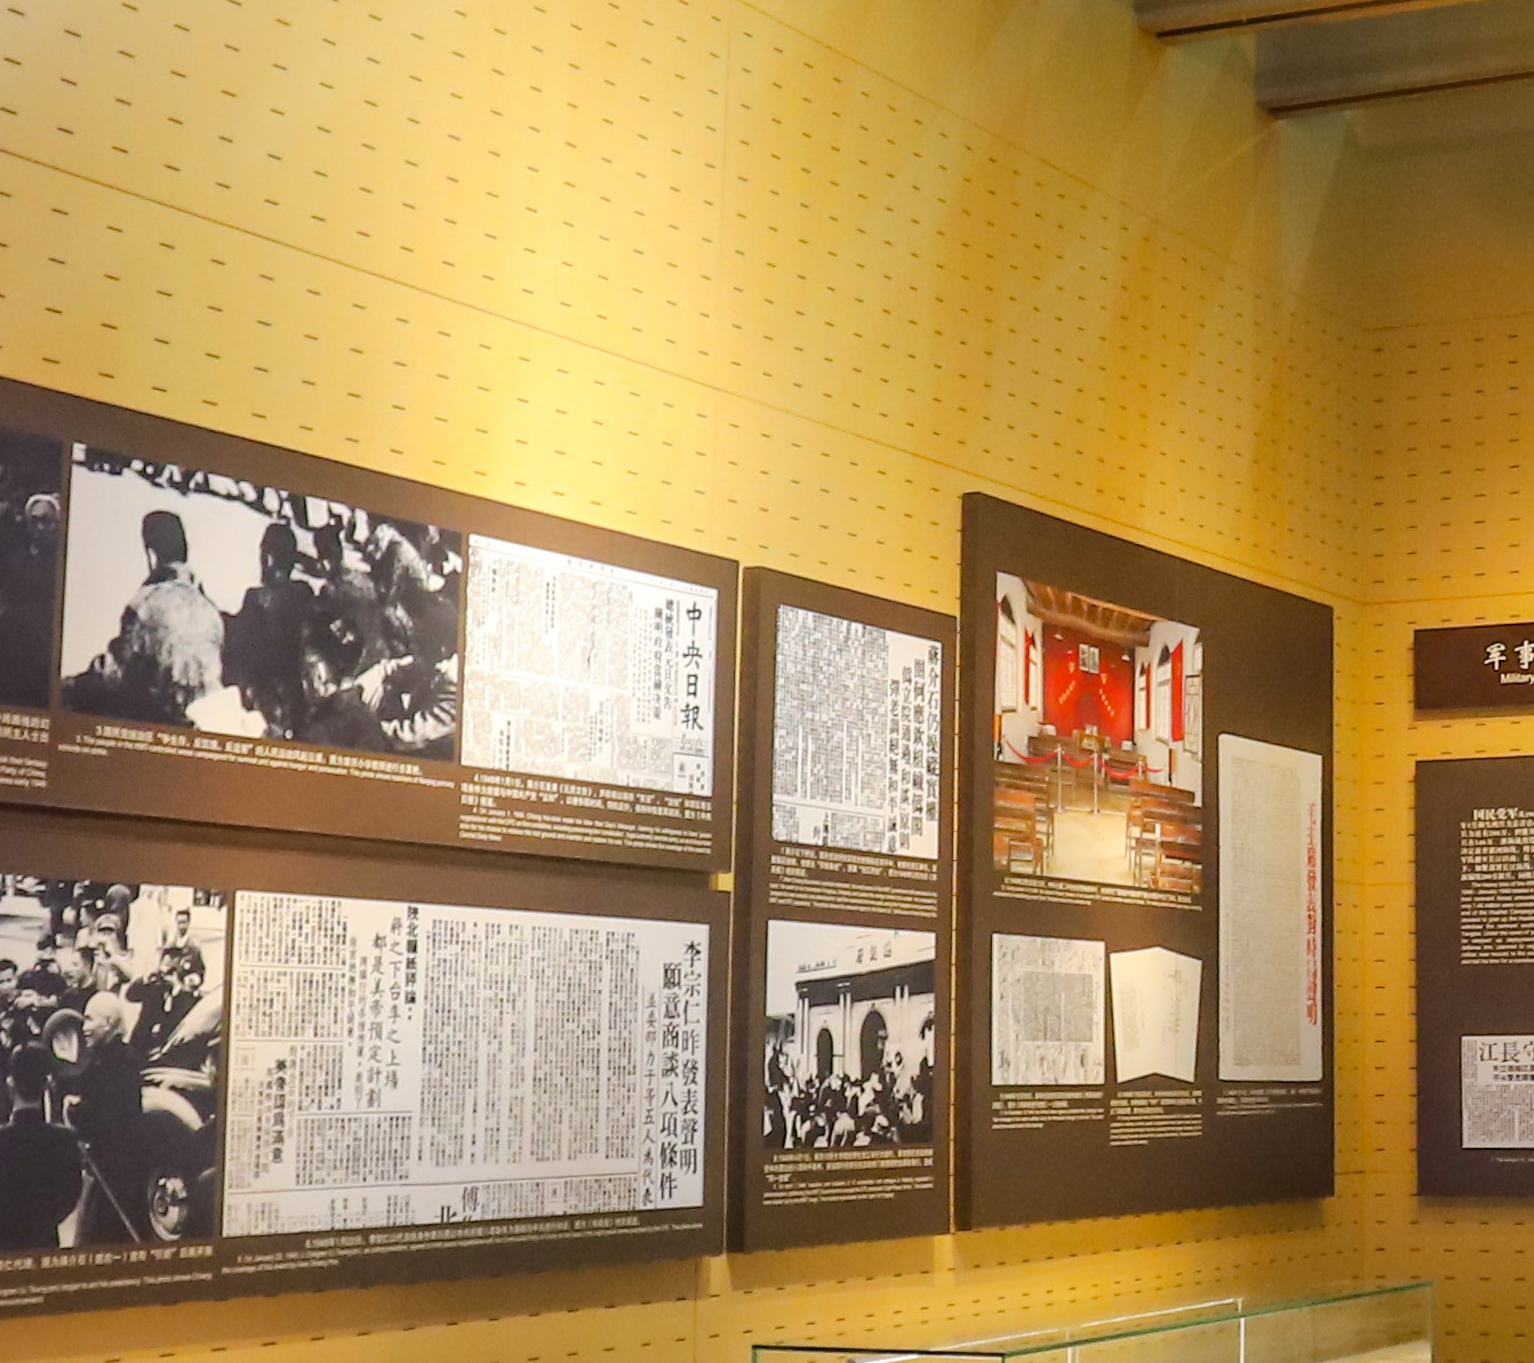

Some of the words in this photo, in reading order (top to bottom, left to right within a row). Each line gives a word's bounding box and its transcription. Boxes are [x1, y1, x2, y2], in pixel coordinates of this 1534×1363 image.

[680, 601, 703, 731] 中央日報
[659, 962, 682, 1202] 願意商談八項條件
[679, 939, 703, 1176] 李宗仁昨發表聲明
